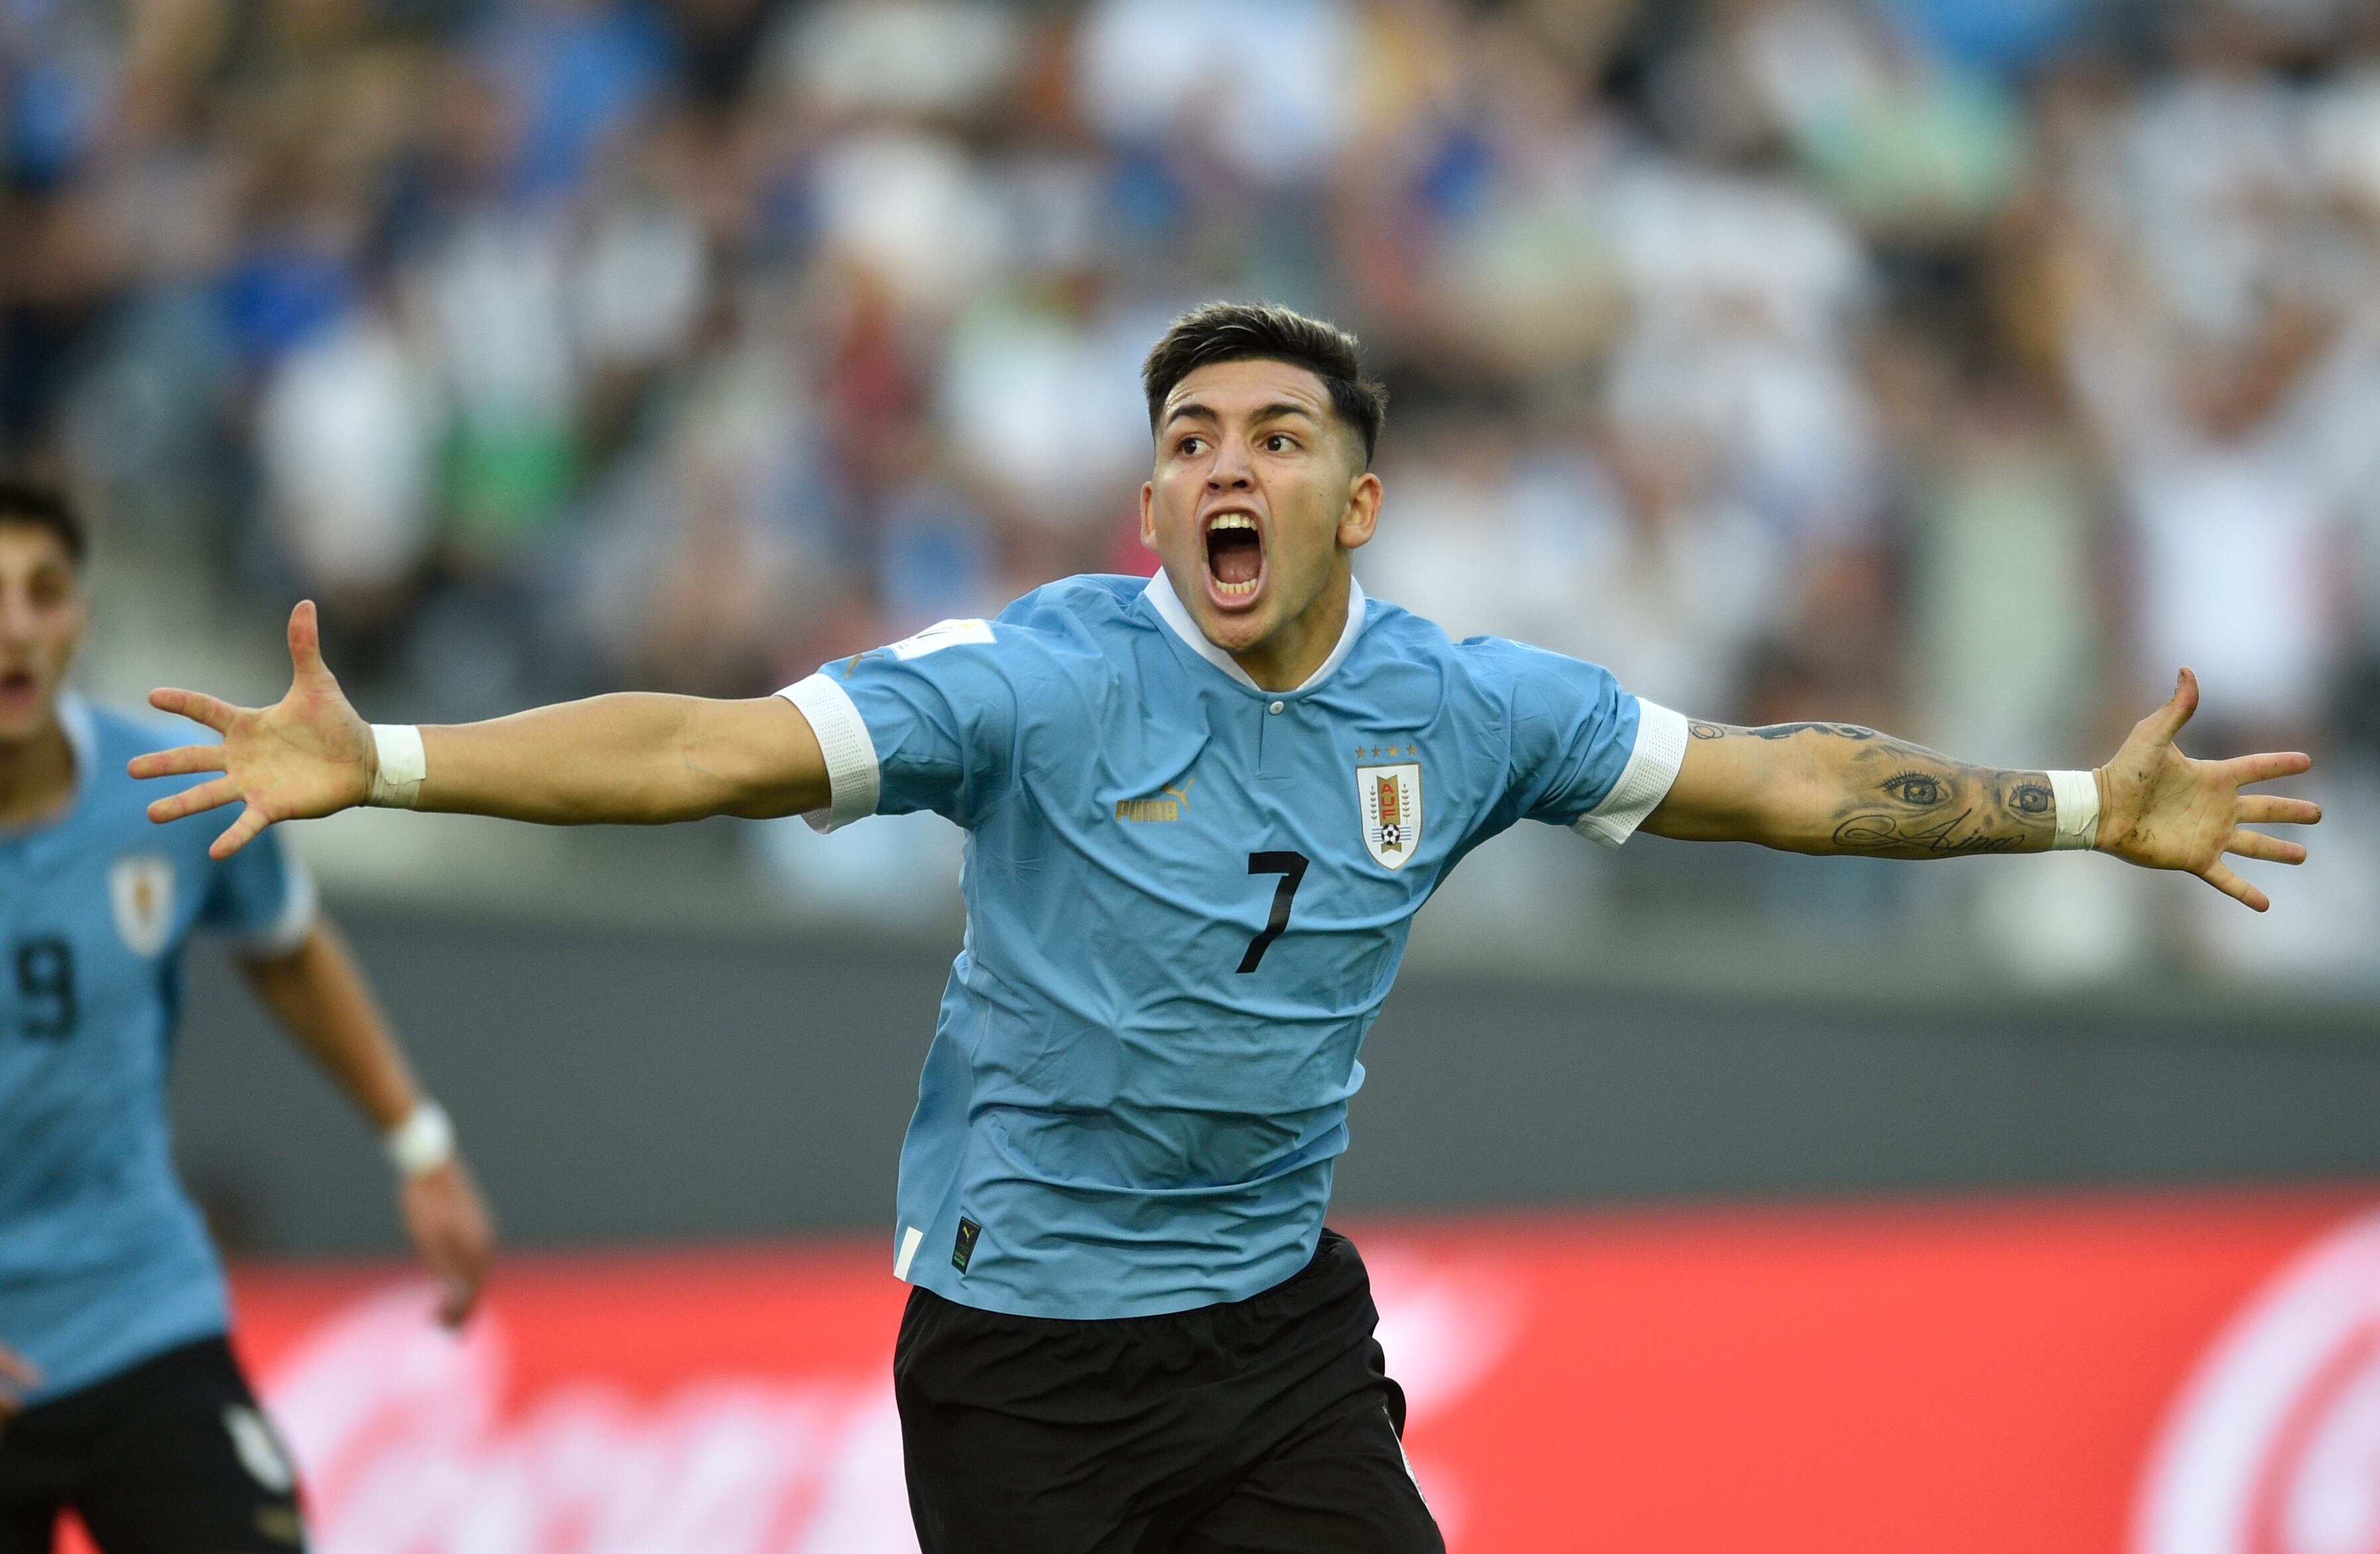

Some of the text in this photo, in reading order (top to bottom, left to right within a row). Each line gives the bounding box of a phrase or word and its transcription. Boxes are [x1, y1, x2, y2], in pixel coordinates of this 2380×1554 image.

[1116, 799, 1178, 822] PUMA
[1381, 783, 1395, 820] AUF
[1235, 851, 1310, 974] 7
[17, 937, 76, 1038] 9
